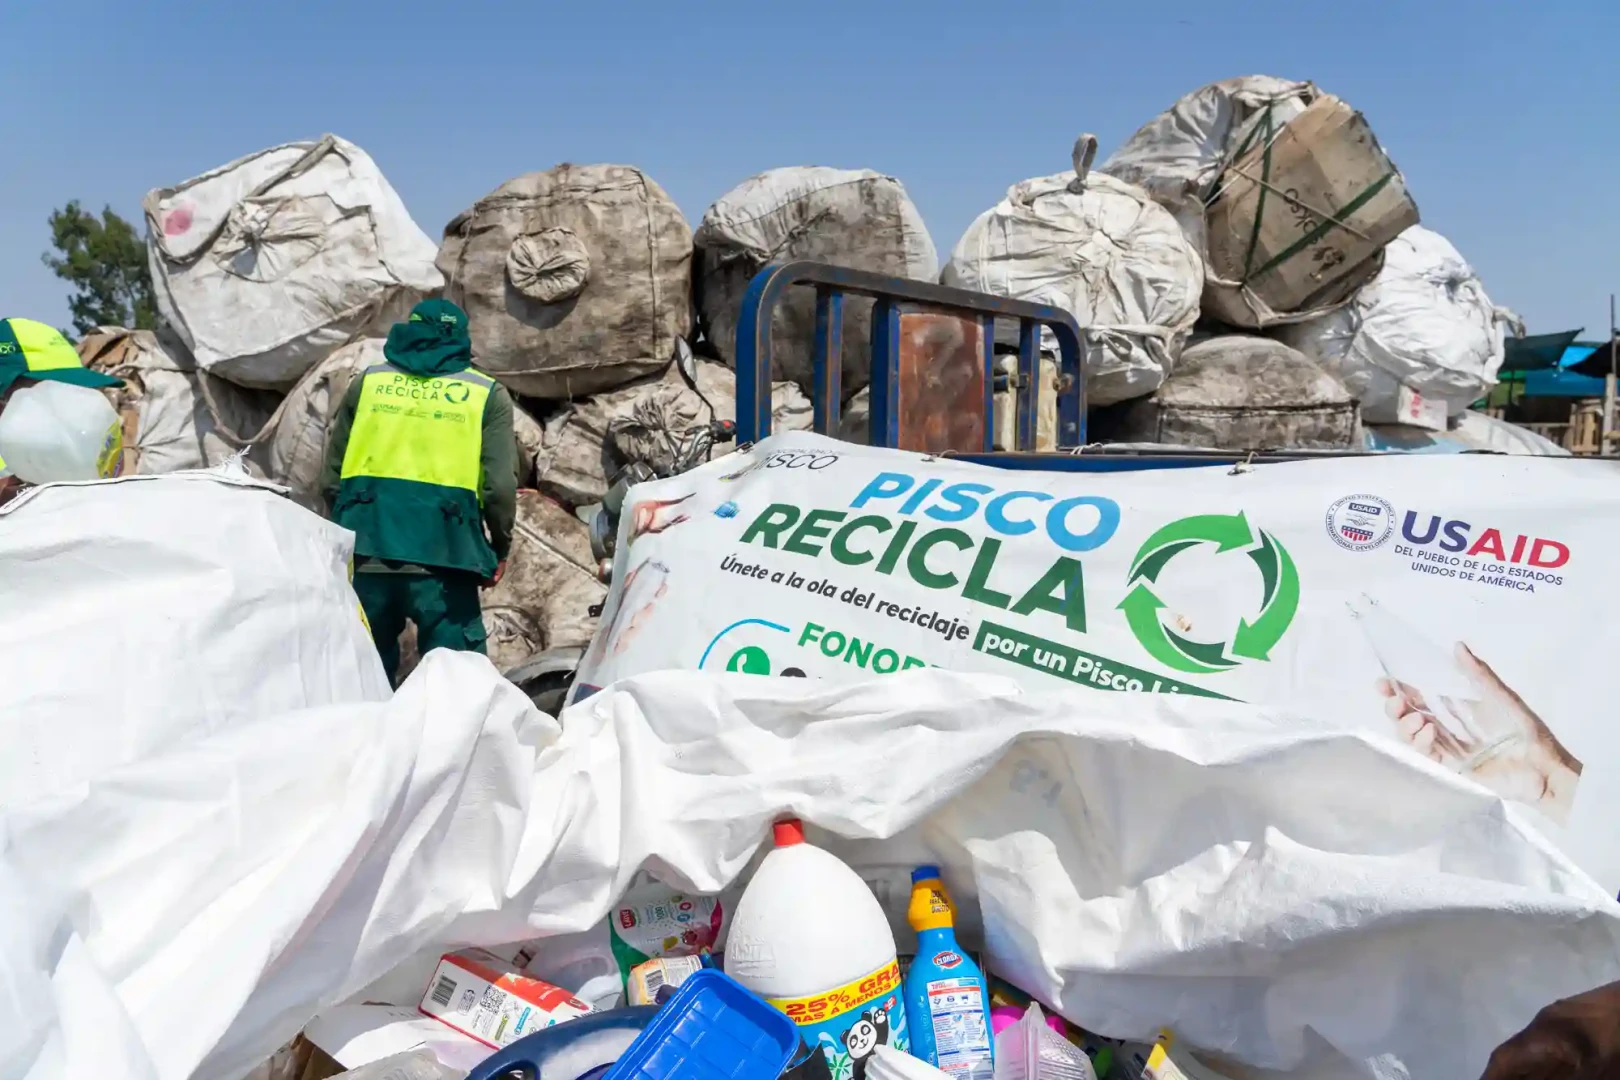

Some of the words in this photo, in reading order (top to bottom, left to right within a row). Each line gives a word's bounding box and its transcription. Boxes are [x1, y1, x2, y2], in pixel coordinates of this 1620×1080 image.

[375, 384, 439, 401] RECICLA
[393, 374, 443, 390] PISCO
[849, 472, 1121, 552] PISCO
[1351, 504, 1378, 514] USAID
[1401, 510, 1571, 569] USAID
[739, 503, 1088, 634] RECICLA
[1394, 544, 1413, 557] DEL
[1417, 550, 1460, 566] PUEBLO
[1463, 560, 1479, 570] DE
[1482, 563, 1505, 574] LOS
[1508, 567, 1563, 586] ESTADOS
[1411, 562, 1456, 578] UNIDOS
[1459, 571, 1475, 581] DE
[1477, 574, 1535, 593] AMÉRICA
[720, 554, 768, 580] Únete
[771, 571, 785, 584] a
[785, 571, 804, 589] la
[807, 579, 838, 598] ola
[840, 587, 875, 610] del
[875, 600, 970, 641] reciclaje
[981, 631, 1030, 658] por
[1033, 648, 1067, 673] un
[1072, 655, 1144, 693] Pisco
[797, 622, 940, 674] FONO
[786, 990, 850, 1016] 25%
[831, 1006, 840, 1015] A
[845, 982, 892, 1009] MENOS
